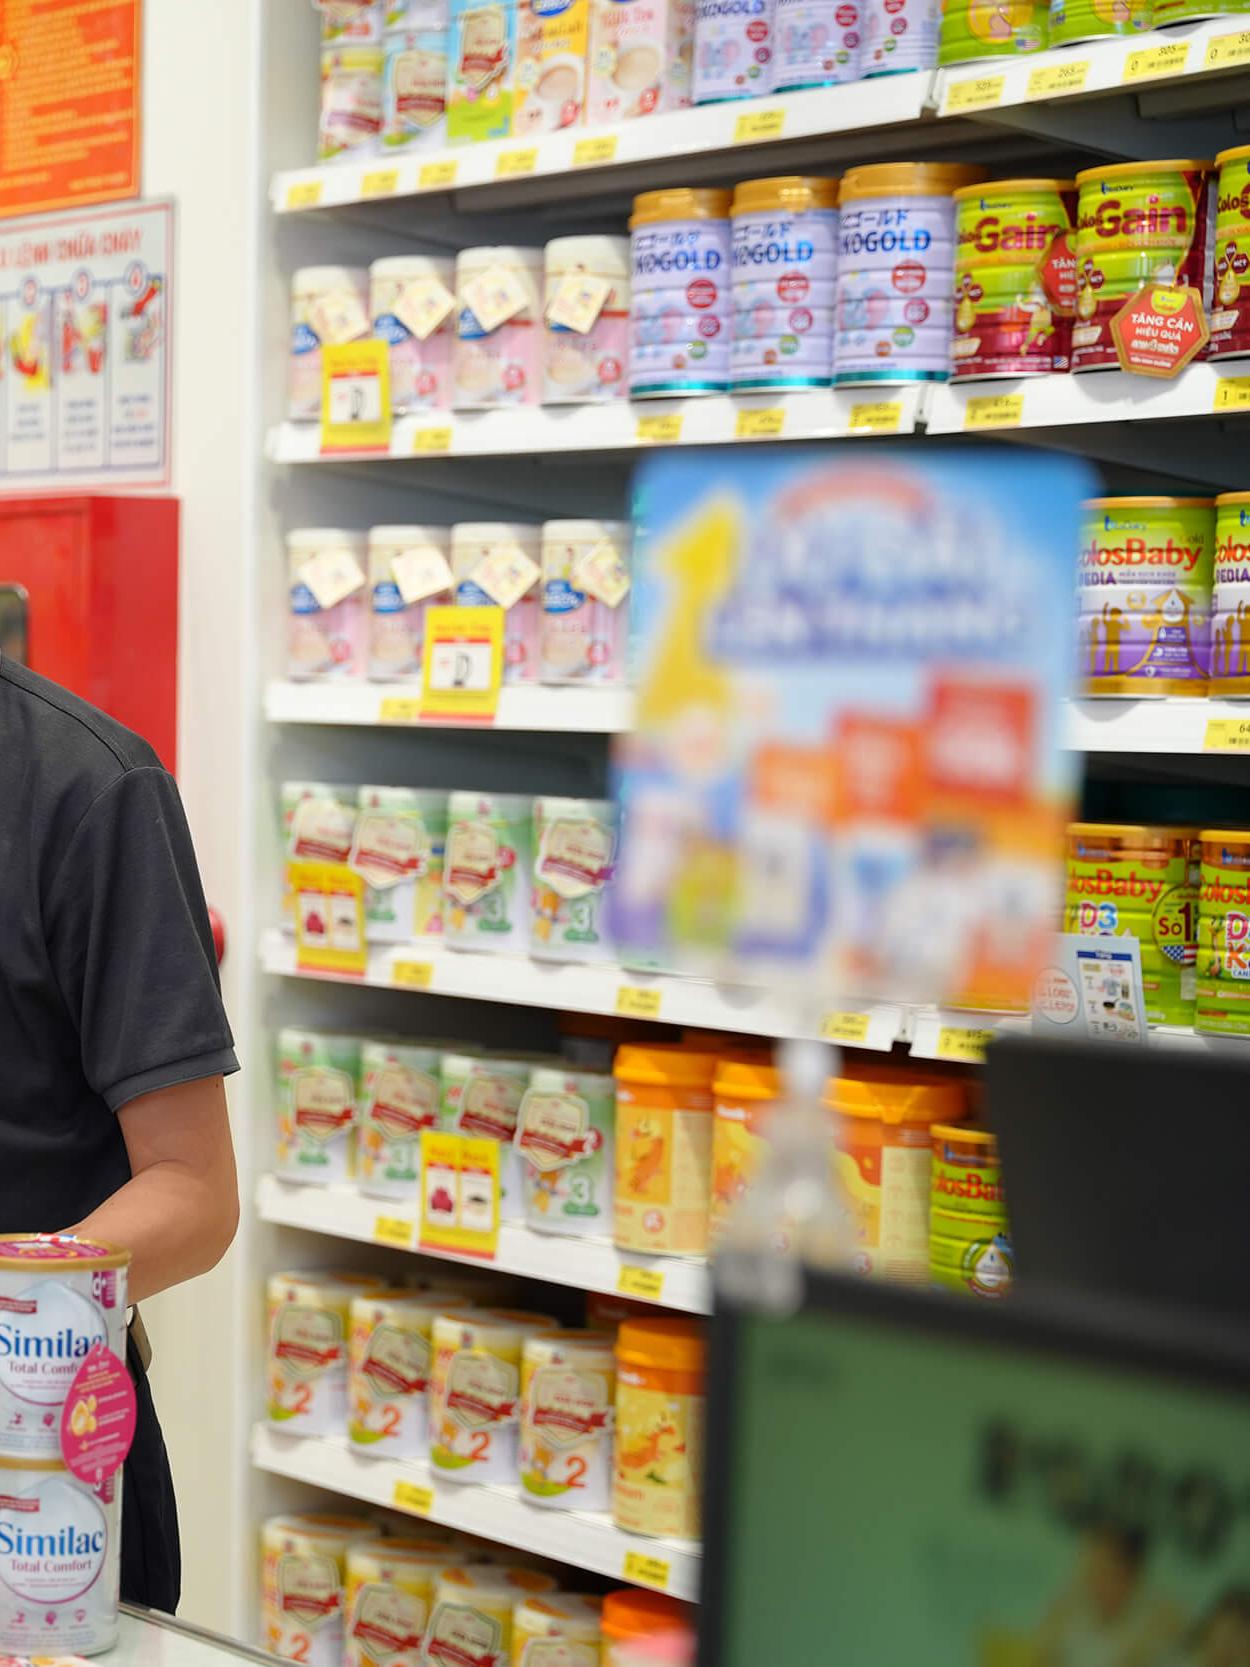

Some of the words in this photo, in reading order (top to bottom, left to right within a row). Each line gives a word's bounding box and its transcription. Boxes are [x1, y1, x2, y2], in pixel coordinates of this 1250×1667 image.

[1131, 312, 1164, 326] TĂNG
[1079, 538, 1203, 571] olosBaby
[1070, 868, 1165, 903] losBaby
[1200, 873, 1250, 906] Colos
[1079, 901, 1118, 930] D3
[7, 1360, 38, 1374] Total
[382, 1404, 403, 1438] 2
[468, 1429, 491, 1462] 2
[565, 1454, 589, 1489] 2
[10, 1558, 40, 1574] Total
[44, 1557, 92, 1574] Comfort
